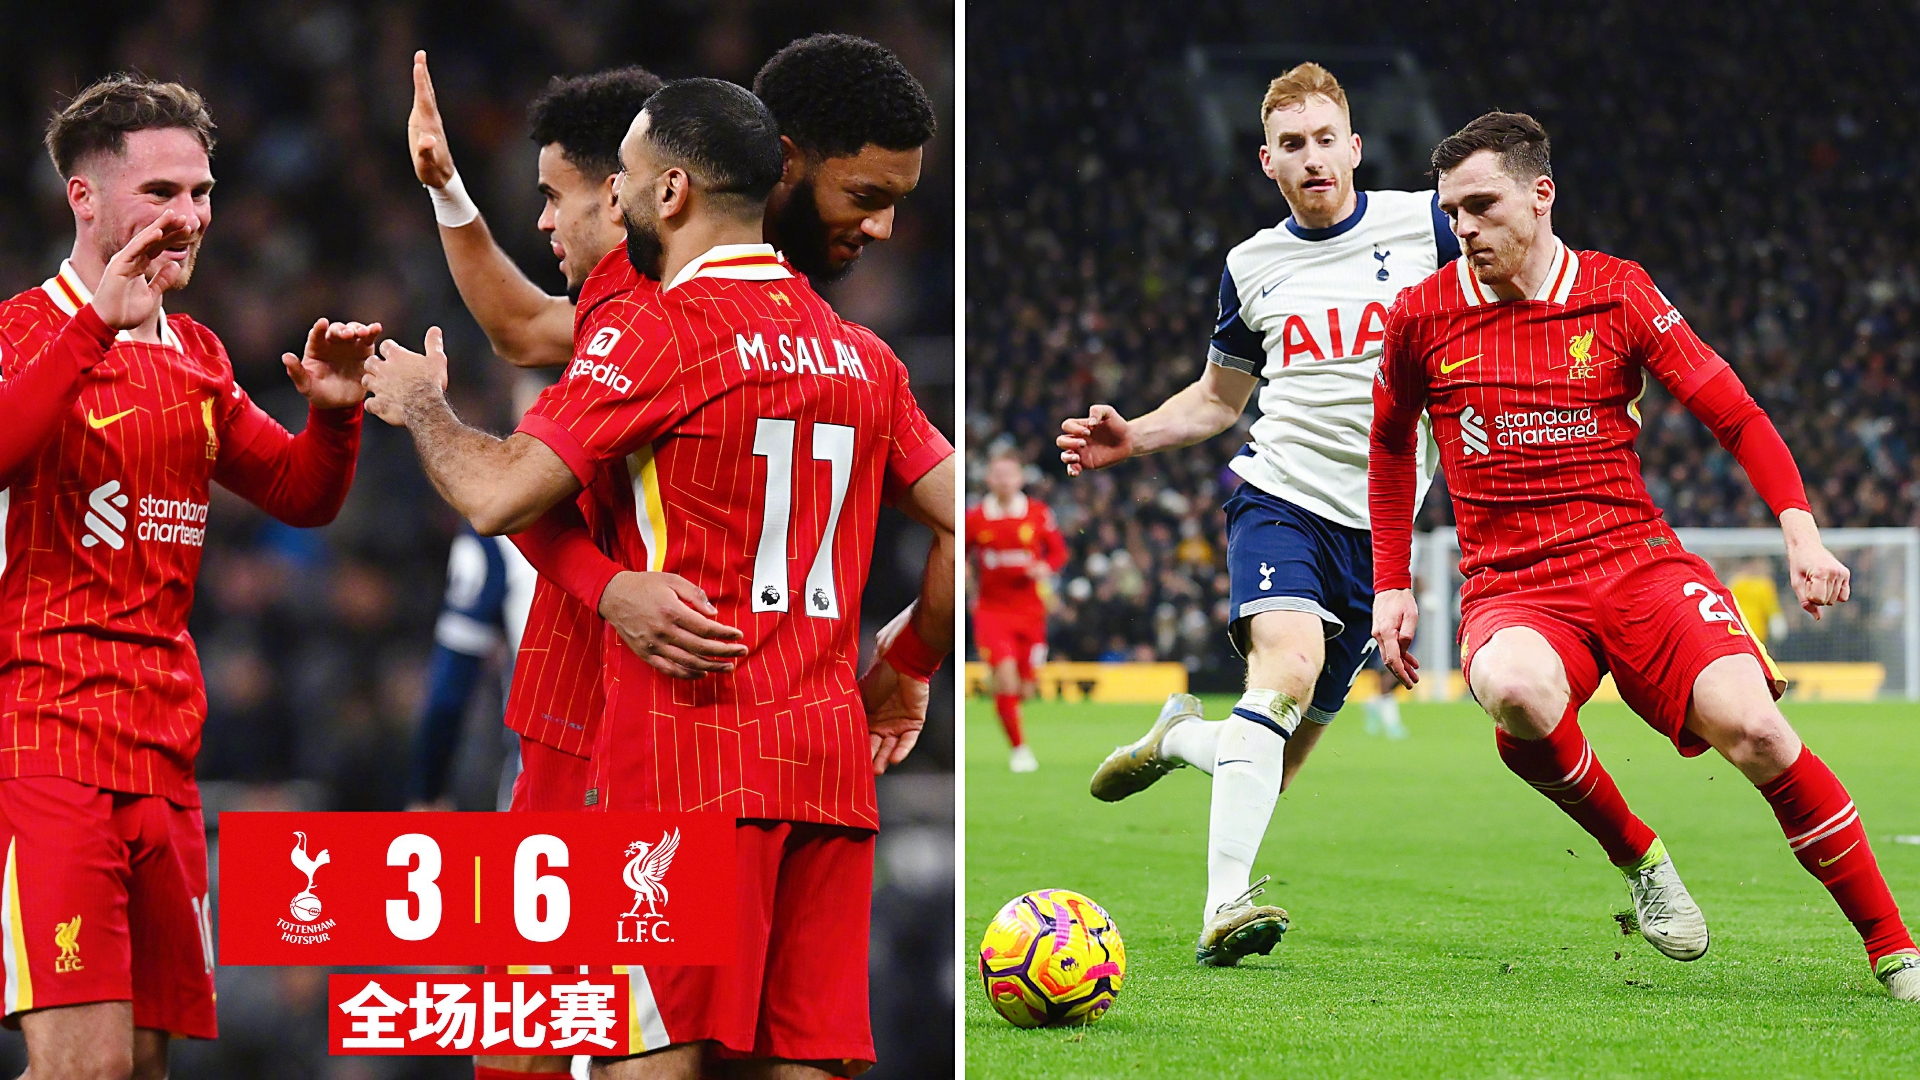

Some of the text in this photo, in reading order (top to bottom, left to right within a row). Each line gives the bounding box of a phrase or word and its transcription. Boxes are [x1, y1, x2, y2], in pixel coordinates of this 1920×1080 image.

[1282, 301, 1390, 368] AIA
[735, 332, 868, 381] M.SALAH
[569, 356, 633, 394] pedia
[1494, 406, 1592, 429] standard
[1497, 418, 1598, 446] chartered
[138, 494, 210, 523] standard
[137, 519, 206, 547] chartered
[1683, 581, 1744, 630] 2
